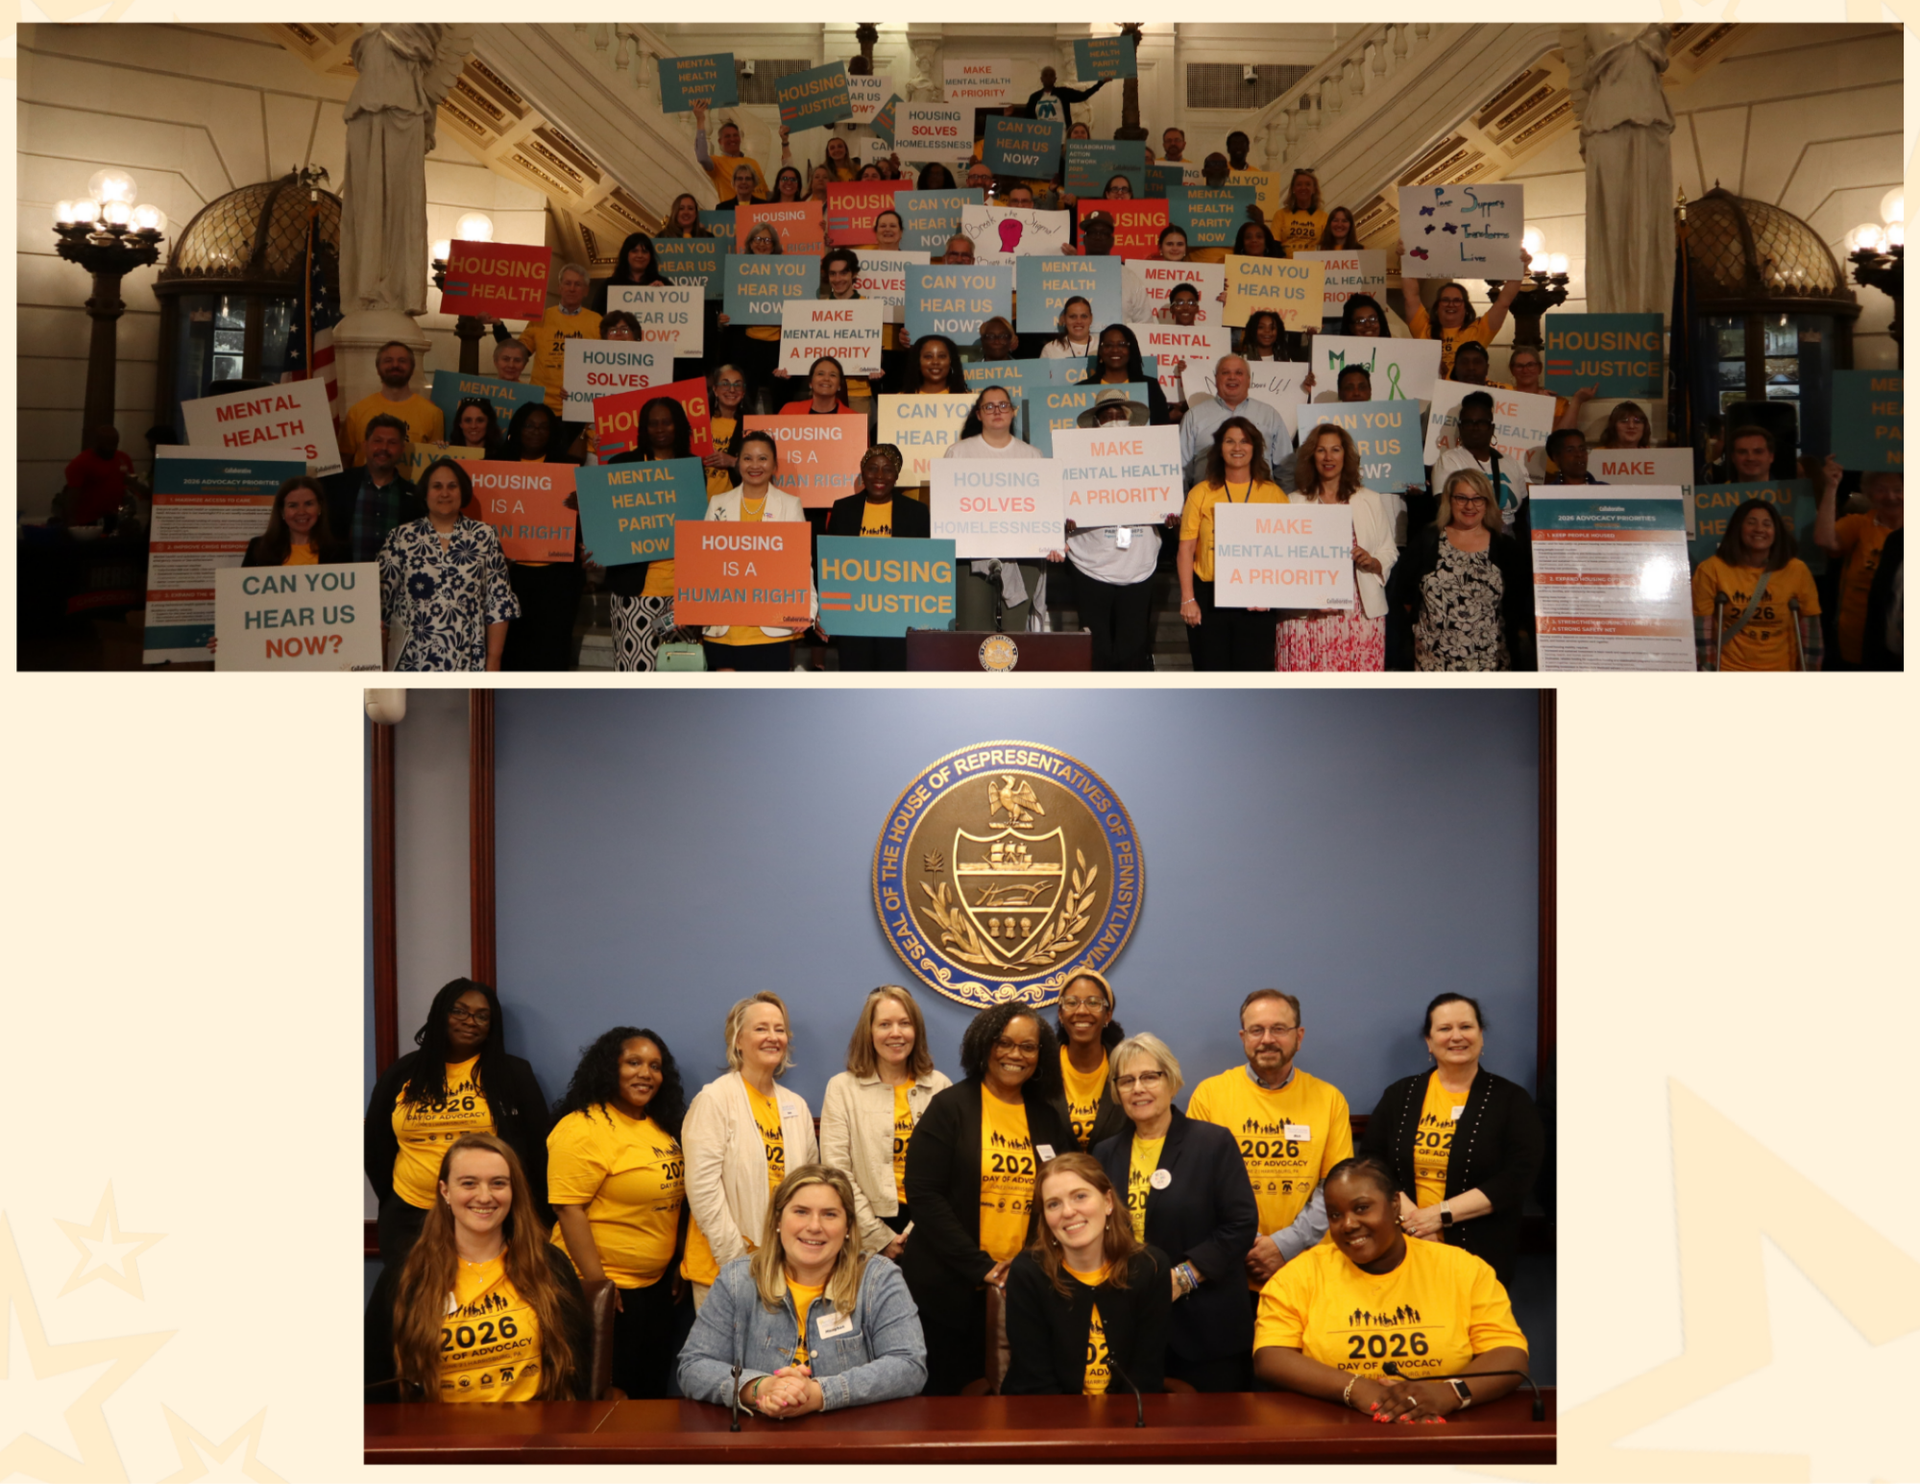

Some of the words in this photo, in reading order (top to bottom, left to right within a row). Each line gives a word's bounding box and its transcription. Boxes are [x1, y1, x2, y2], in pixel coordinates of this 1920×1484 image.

[1088, 39, 1119, 48] MENTAL
[1090, 50, 1120, 58] HEALTH
[964, 66, 992, 74] MAKE
[1092, 59, 1120, 68] PARITY
[682, 84, 716, 94] PARITY
[778, 74, 846, 102] HOUSING
[861, 79, 882, 88] YOU
[946, 78, 977, 86] MENTAL
[867, 93, 880, 101] US
[952, 90, 959, 98] A
[961, 89, 1006, 98] PRIORITY
[798, 94, 848, 116] JUSTICE
[909, 110, 961, 120] HOUSING
[912, 126, 958, 136] SOLVES
[896, 140, 972, 149] HOMELESSNESS
[1032, 142, 1048, 152] US
[1002, 153, 1040, 166] NOW?
[1244, 177, 1268, 185] YOU
[1188, 190, 1234, 199] MENTAL
[908, 199, 938, 210] CAN
[1188, 204, 1234, 214] HEALTH
[752, 211, 806, 222] HOUSING
[1190, 218, 1232, 228] PARITY
[1198, 233, 1226, 242] NOW
[655, 244, 684, 254] CAN
[688, 244, 715, 253] YOU
[450, 256, 546, 280] HOUSING
[739, 264, 770, 276] CAN
[774, 264, 806, 276] YOU
[1042, 262, 1096, 272] MENTAL
[1240, 262, 1273, 276] CAN
[1277, 265, 1310, 279] YOU
[1145, 268, 1204, 282] MENTAL
[1341, 276, 1385, 284] HEALTH
[738, 284, 778, 296] HEAR
[782, 284, 802, 296] US
[922, 276, 956, 289] CAN
[962, 276, 996, 290] YOU
[1042, 280, 1096, 290] HEALTH
[472, 284, 542, 302] HEALTH
[623, 292, 656, 303] CAN
[659, 292, 690, 303] YOU
[1238, 284, 1280, 298] HEAR
[1284, 288, 1306, 300] US
[920, 299, 966, 312] HEAR
[970, 299, 992, 312] US
[668, 312, 688, 324] US
[812, 310, 854, 322] MAKE
[783, 330, 830, 338] MENTAL
[834, 329, 880, 338] HEALTH
[1150, 333, 1211, 347] MENTAL
[1549, 332, 1660, 351] HOUSING
[583, 352, 654, 366] HOUSING
[790, 348, 800, 358] A
[1575, 360, 1660, 377] JUSTICE
[586, 372, 649, 388] SOLVES
[460, 380, 516, 400] MENTAL
[216, 394, 301, 422] MENTAL
[1046, 393, 1086, 408] CAN
[898, 404, 938, 419] CAN
[1362, 412, 1402, 428] YOU
[222, 419, 305, 447] HEALTH
[896, 430, 948, 445] HEAR
[1090, 440, 1144, 457] MAKE
[1376, 440, 1400, 455] US
[788, 450, 802, 463] IS
[807, 451, 818, 463] A
[1122, 464, 1180, 478] HEALTH
[1602, 462, 1655, 476] MAKE
[472, 474, 552, 490] HOUSING
[608, 468, 674, 486] MENTAL
[954, 472, 1040, 488] HOUSING
[612, 490, 676, 509] HEALTH
[1069, 491, 1082, 506] A
[1087, 486, 1170, 505] PRIORITY
[491, 498, 508, 513] IS
[512, 500, 525, 514] A
[960, 497, 1036, 512] SOLVES
[519, 525, 573, 540] RIGHT
[934, 521, 1062, 534] HOMELESSNESS
[1256, 518, 1312, 534] MAKE
[630, 537, 670, 554] NOW
[702, 536, 784, 551] HOUSING
[1218, 544, 1282, 557] MENTAL
[1288, 545, 1350, 558] HEALTH
[722, 562, 740, 576] IS
[744, 562, 758, 576] A
[822, 558, 952, 584] HOUSING
[242, 574, 296, 596] CAN
[304, 572, 356, 592] YOU
[1230, 568, 1242, 584] A
[1250, 569, 1340, 586] PRIORITY
[678, 588, 746, 603] HUMAN
[752, 588, 807, 604] RIGHT
[854, 594, 952, 614] JUSTICE
[244, 607, 314, 630] HEAR
[322, 606, 355, 625] US
[266, 634, 343, 658] NOW?
[928, 766, 952, 790] OF
[954, 748, 1112, 814] REPRESENTATIVES
[888, 784, 932, 843] HOUSE
[1106, 812, 1128, 836] OF
[882, 845, 900, 881] THE
[884, 886, 900, 912] OF
[1078, 840, 1135, 972] PENNSYLVANIA
[892, 912, 926, 960] SEAL
[416, 1096, 476, 1114] 2026
[440, 1112, 486, 1120] ADVOCACY
[1241, 1140, 1300, 1158] 2026
[441, 1316, 518, 1352] 2026
[452, 1352, 468, 1360] OF
[471, 1337, 532, 1357] ADVOCACY
[1348, 1332, 1429, 1360] 2026
[1338, 1362, 1360, 1371] DAY
[1363, 1362, 1378, 1370] OF
